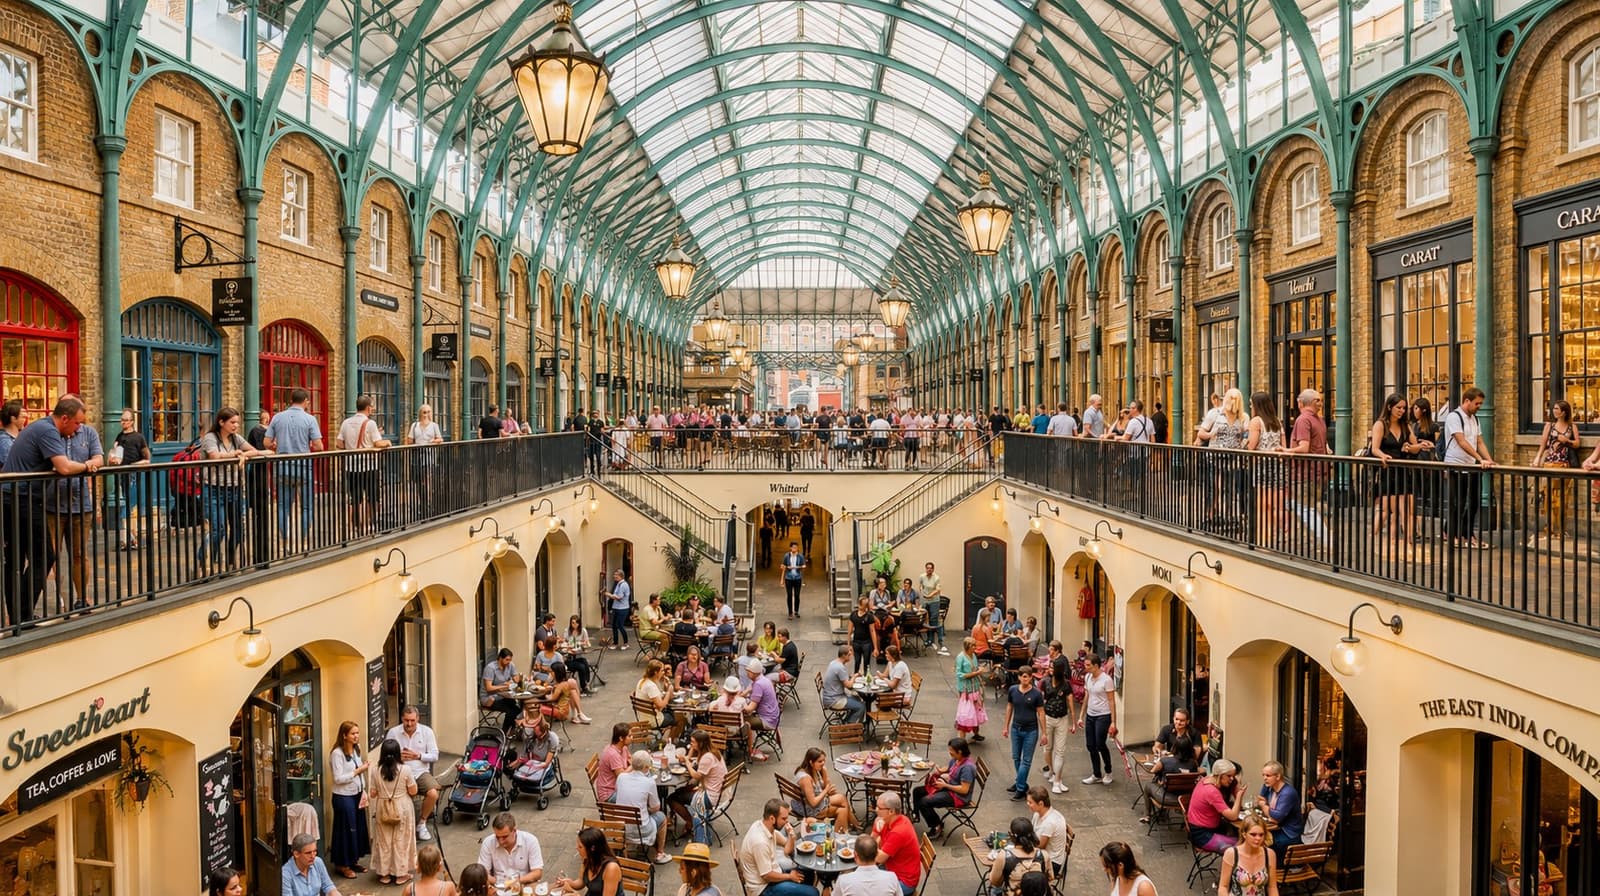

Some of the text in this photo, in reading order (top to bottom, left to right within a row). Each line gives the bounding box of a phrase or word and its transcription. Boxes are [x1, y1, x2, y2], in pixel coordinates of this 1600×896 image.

[769, 483, 809, 493] Whittard
[1152, 564, 1172, 584] MOKI
[2, 687, 150, 770] Sweetheart
[1420, 699, 1447, 720] THE
[1448, 698, 1485, 719] EAST
[1488, 703, 1539, 741] INDIA
[49, 763, 85, 789] COFFEE
[86, 760, 94, 772] &
[94, 749, 117, 769] LOVE
